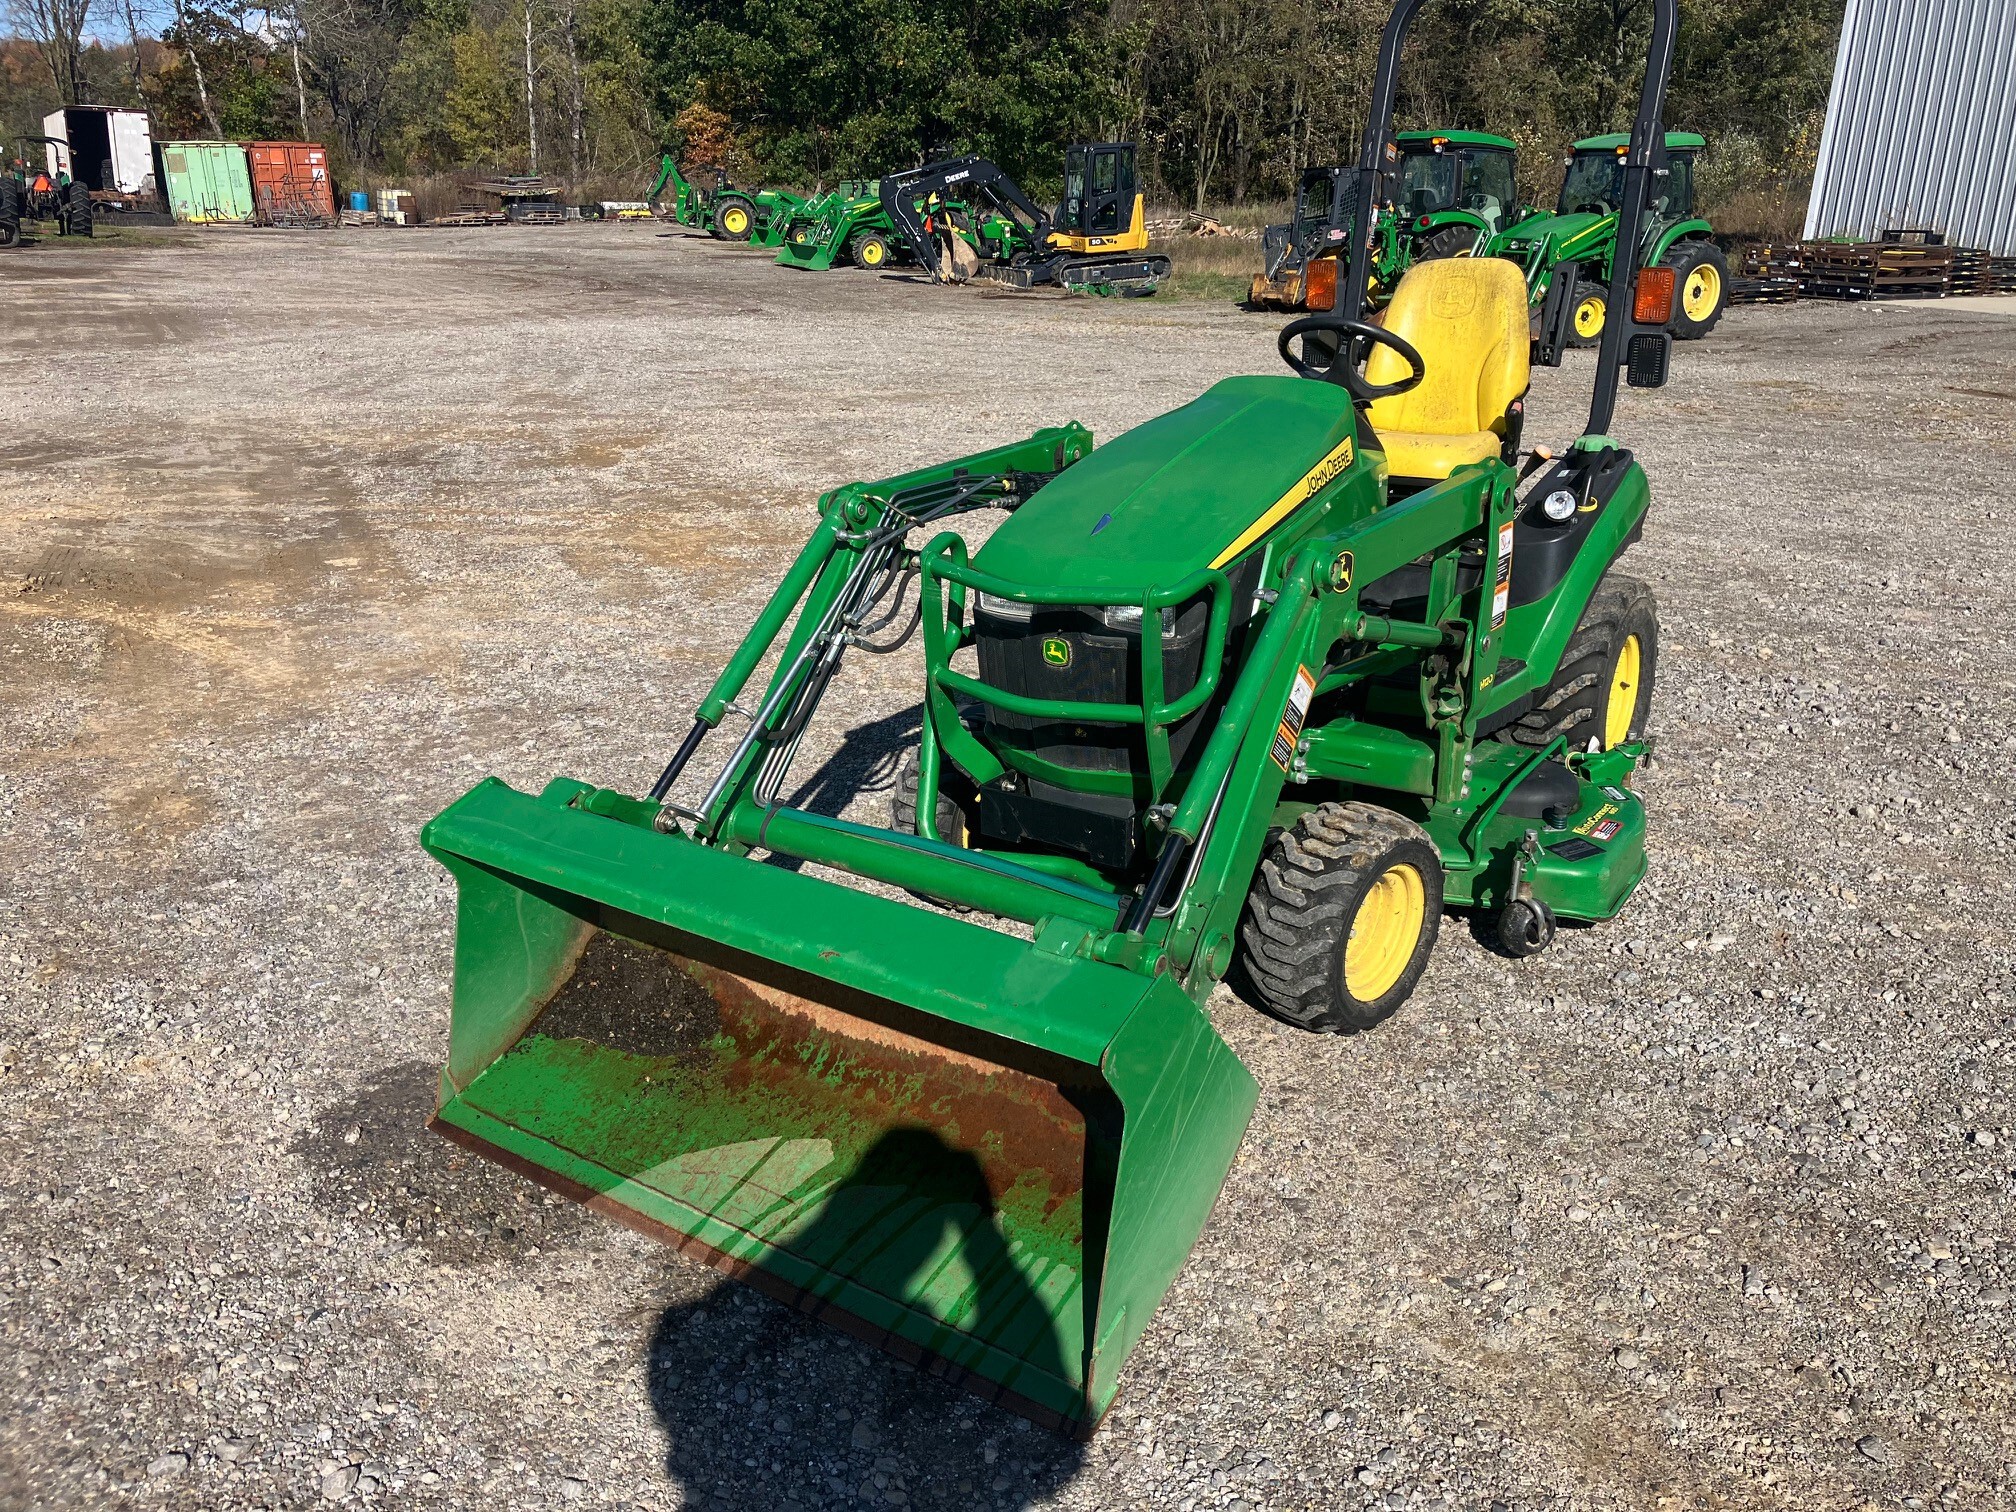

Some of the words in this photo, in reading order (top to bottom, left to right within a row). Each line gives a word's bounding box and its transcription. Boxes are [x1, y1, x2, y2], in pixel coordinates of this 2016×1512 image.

[945, 170, 970, 184] DEERE
[1306, 466, 1328, 496] JOHN
[1326, 449, 1350, 477] DEERE
